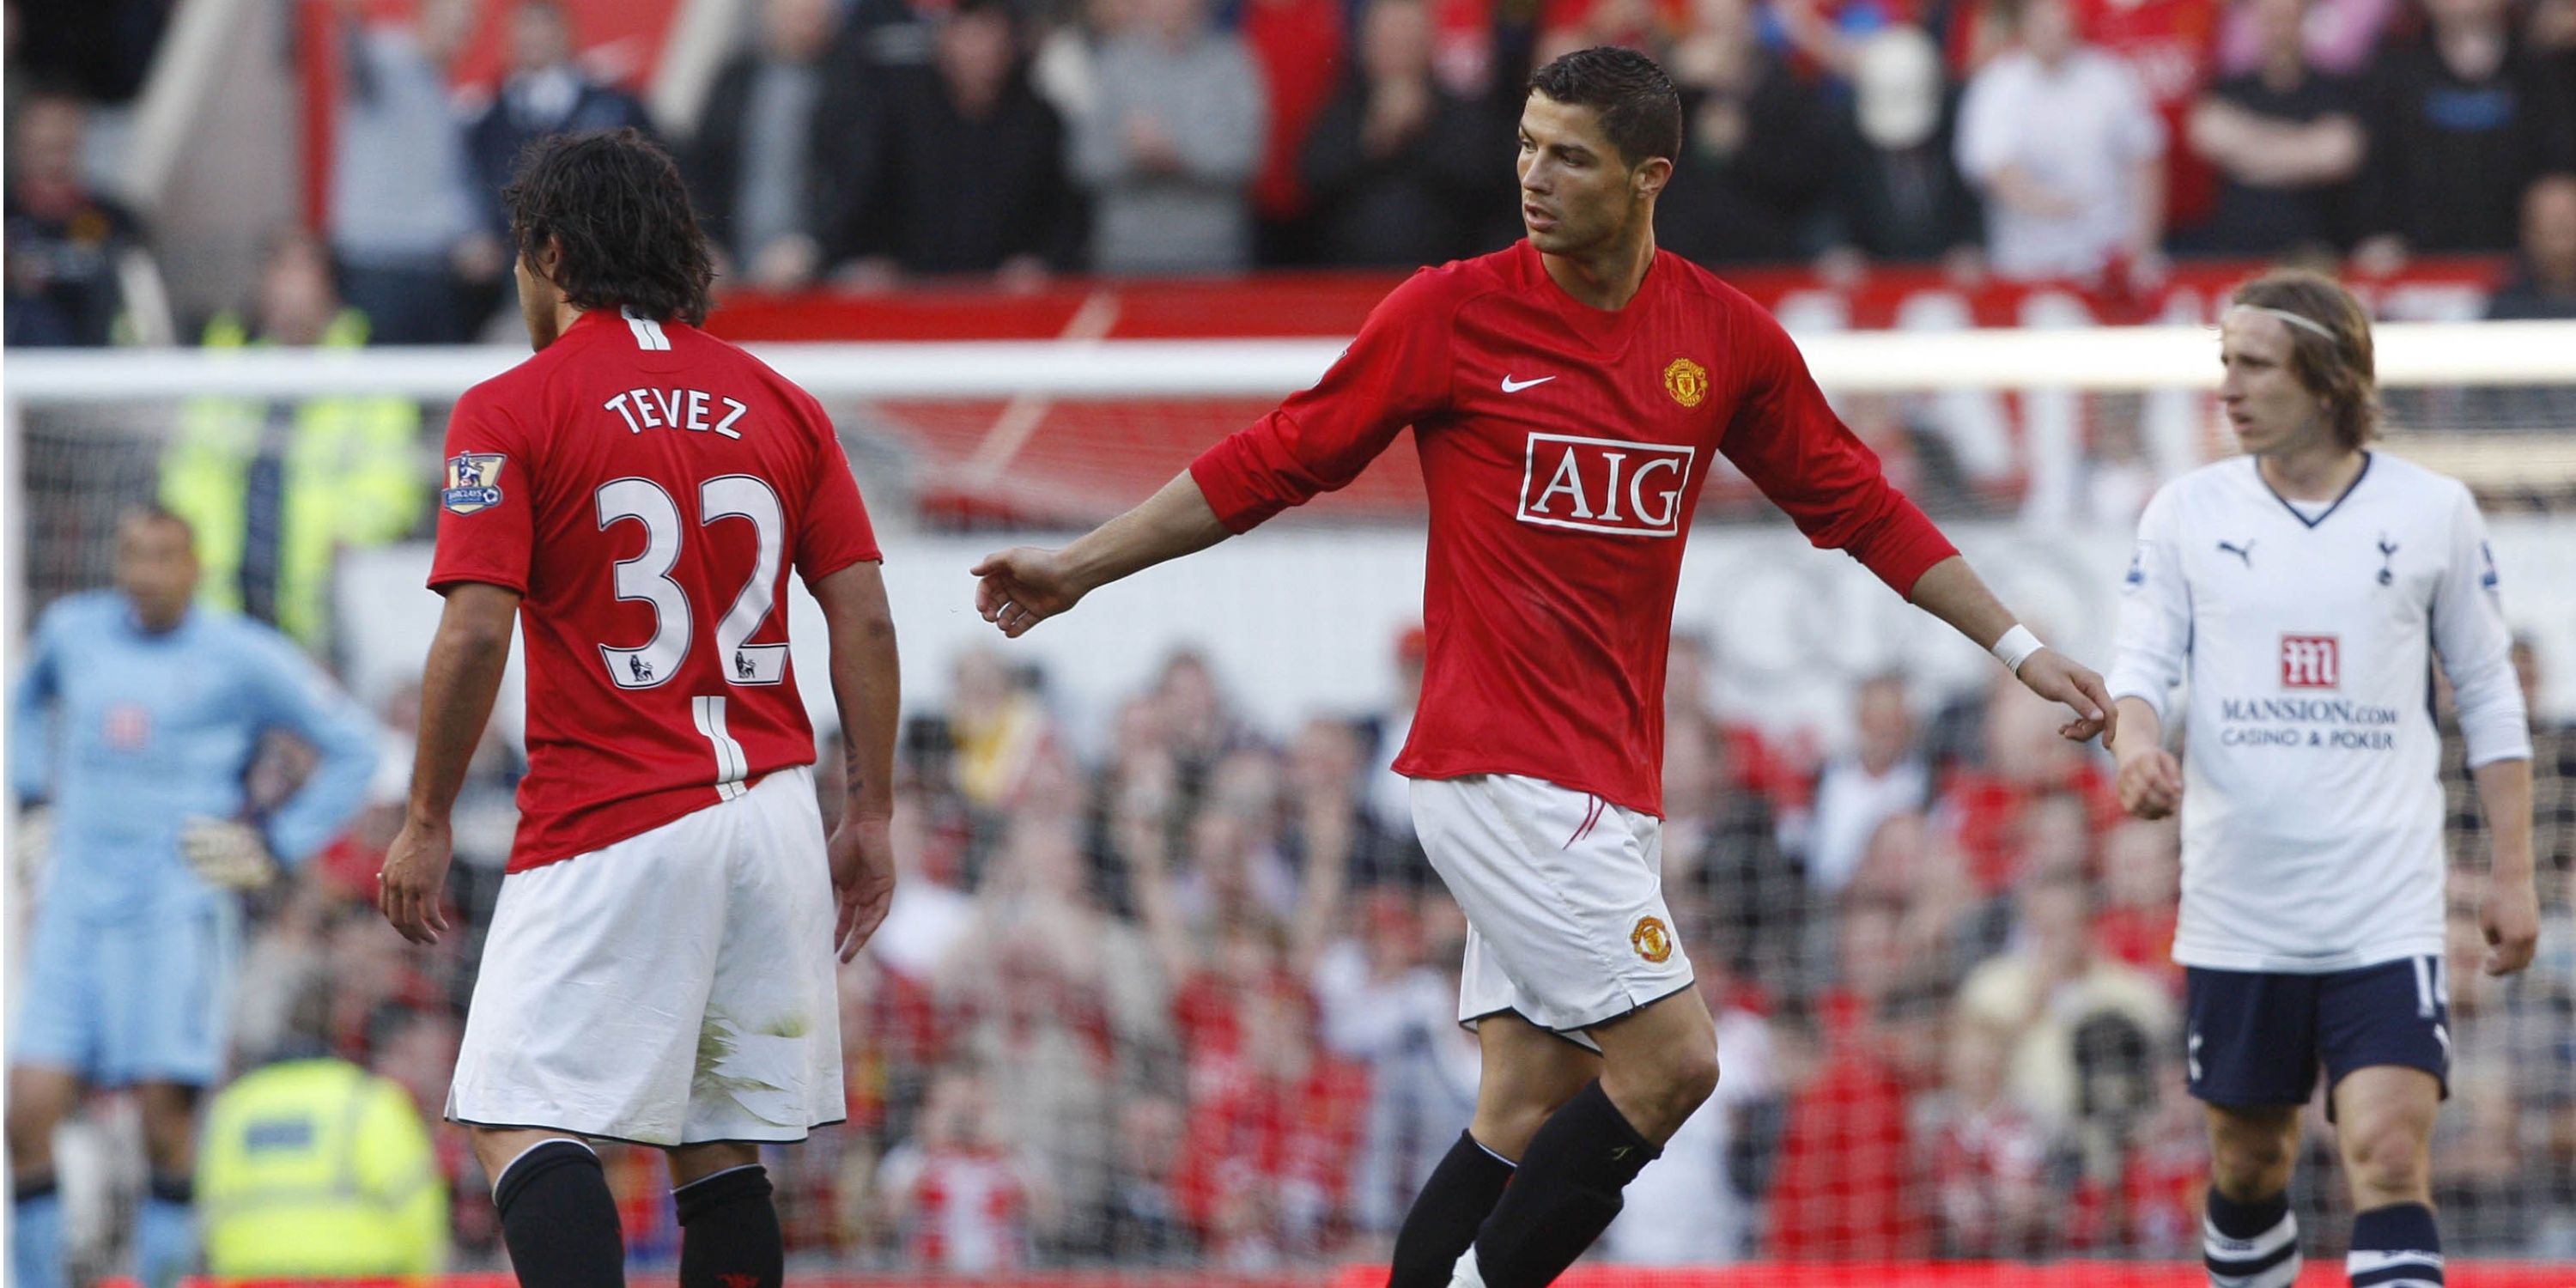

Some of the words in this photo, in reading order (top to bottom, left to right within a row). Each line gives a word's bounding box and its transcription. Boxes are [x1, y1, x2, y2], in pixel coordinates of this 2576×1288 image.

[605, 387, 748, 440] TEVEZ
[1530, 446, 1680, 526] AIG
[596, 474, 790, 690] 32
[2221, 727, 2300, 746] CASINO
[2307, 730, 2321, 746] &
[2330, 730, 2395, 749] POKER
